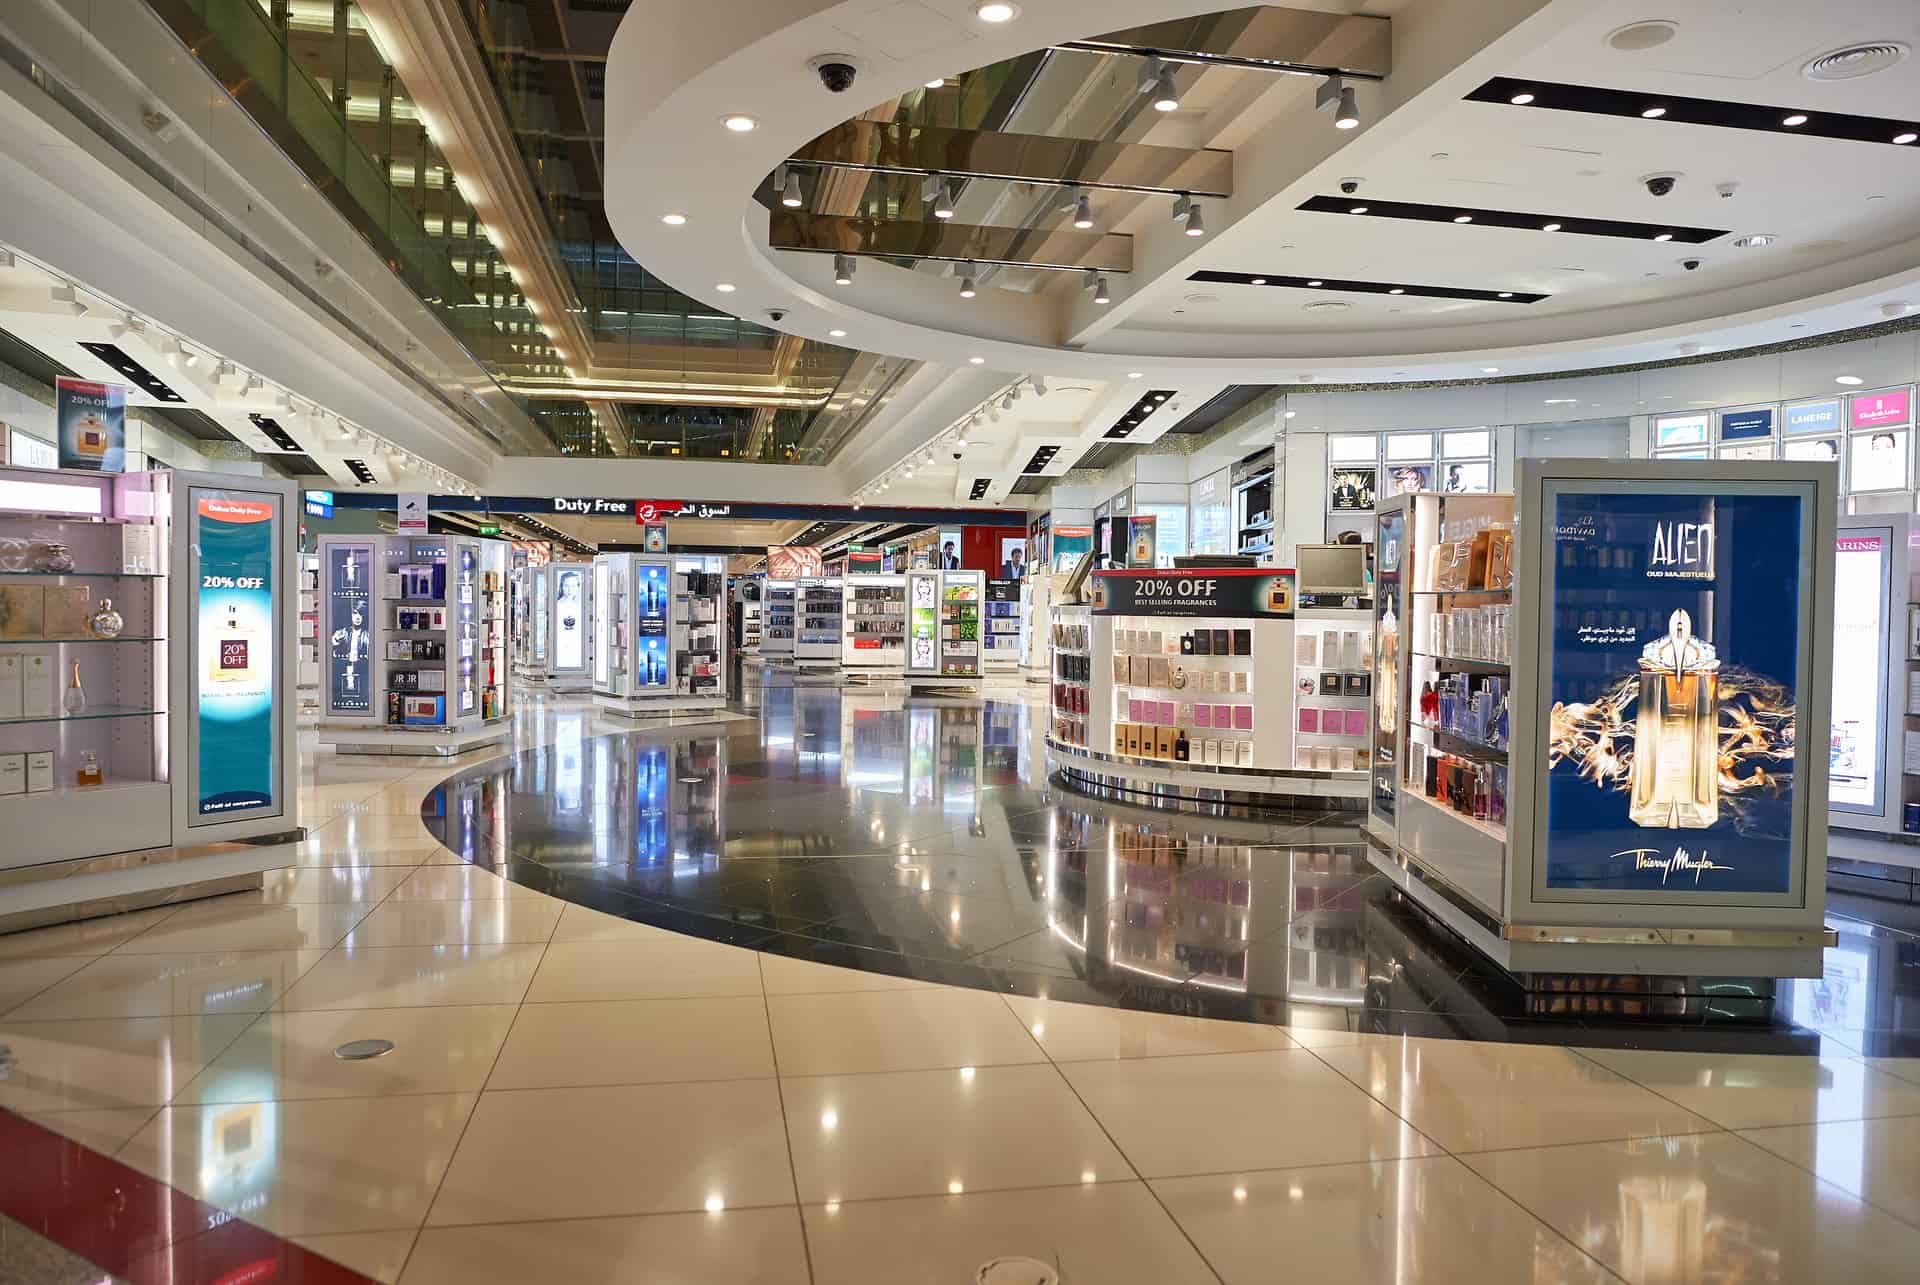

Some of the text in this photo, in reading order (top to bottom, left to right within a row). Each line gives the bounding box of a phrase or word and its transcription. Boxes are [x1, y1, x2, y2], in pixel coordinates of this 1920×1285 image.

[1791, 411, 1833, 425] LANEIGE
[555, 499, 627, 513] Duty Free
[698, 505, 730, 517] السوق
[1646, 570, 1664, 578] OUD
[203, 575, 265, 589] 20% OFF
[1134, 579, 1217, 597] 20% OFF
[1173, 599, 1217, 607] FRAGRANCES
[223, 655, 247, 665] OFF
[1610, 846, 1736, 885] Thierry Mugler
